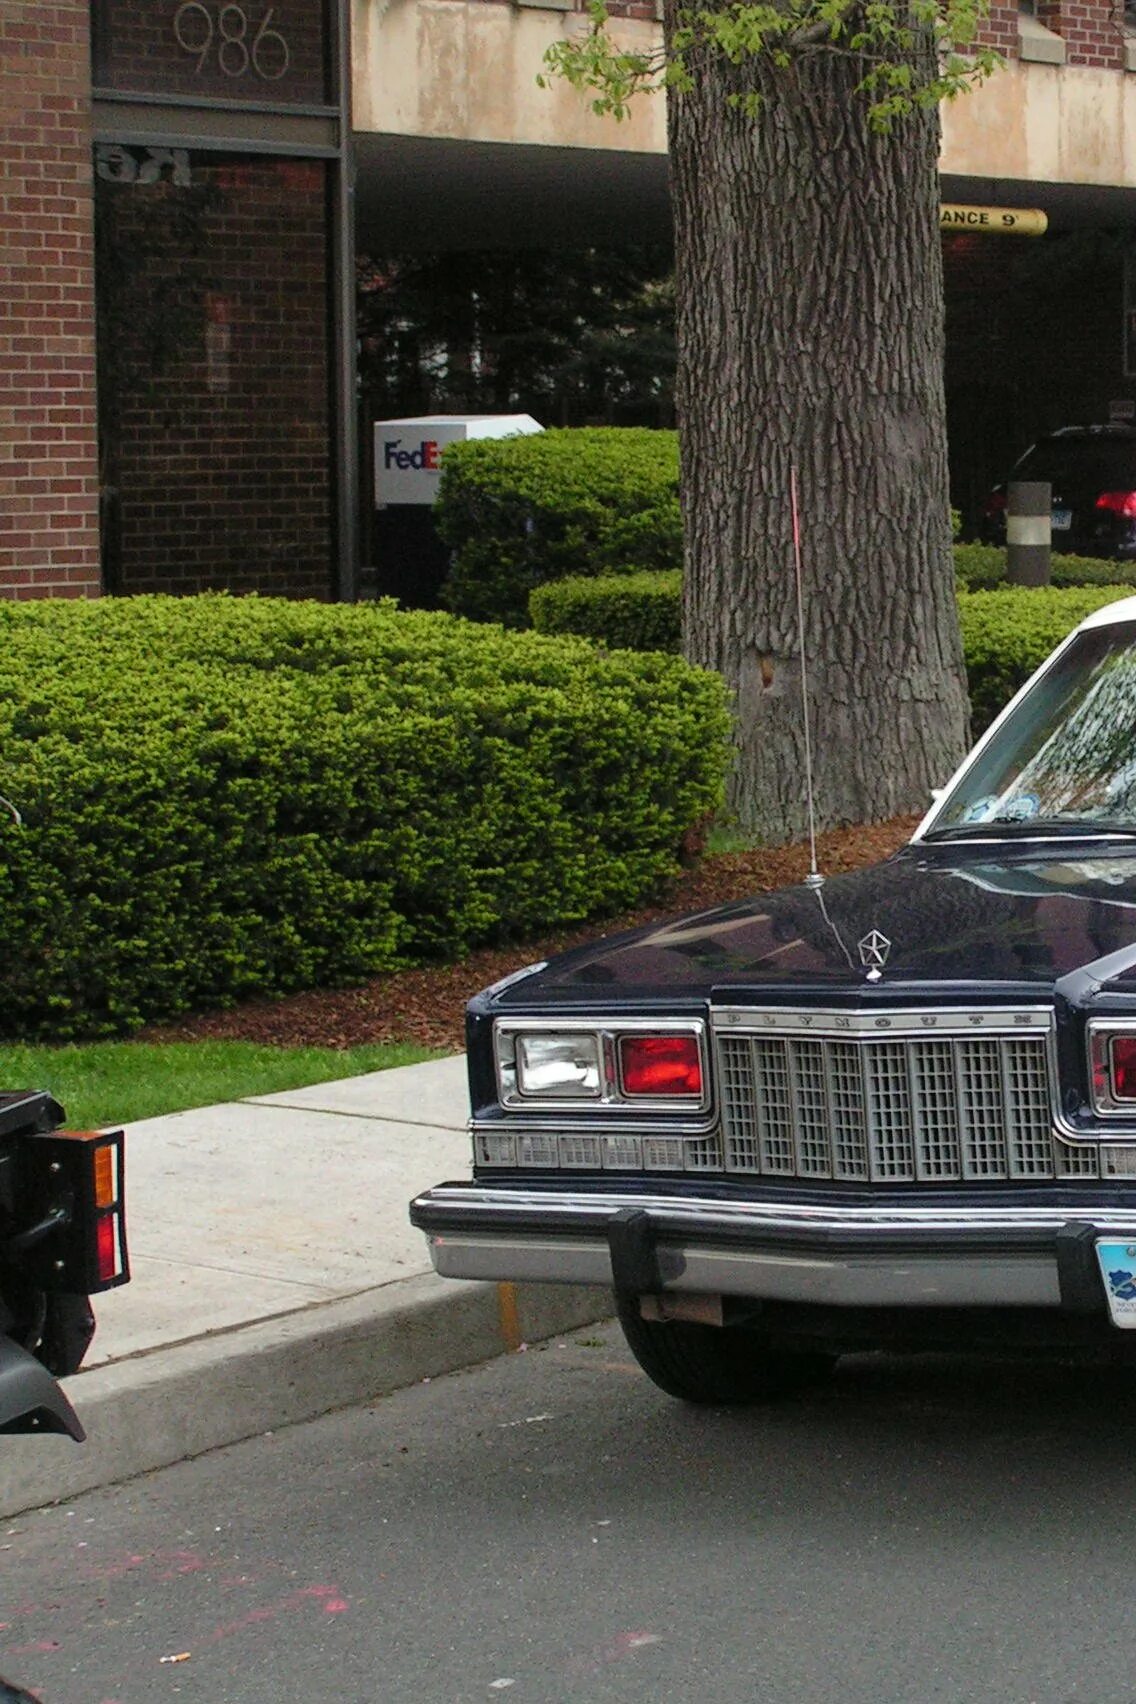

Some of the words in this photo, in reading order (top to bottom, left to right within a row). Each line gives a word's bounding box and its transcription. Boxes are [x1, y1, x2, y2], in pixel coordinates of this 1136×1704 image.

[174, 2, 289, 79] 986
[941, 210, 990, 225] ANCE
[384, 439, 444, 470] FedE
[727, 1013, 1032, 1029] PLYMOUTH
